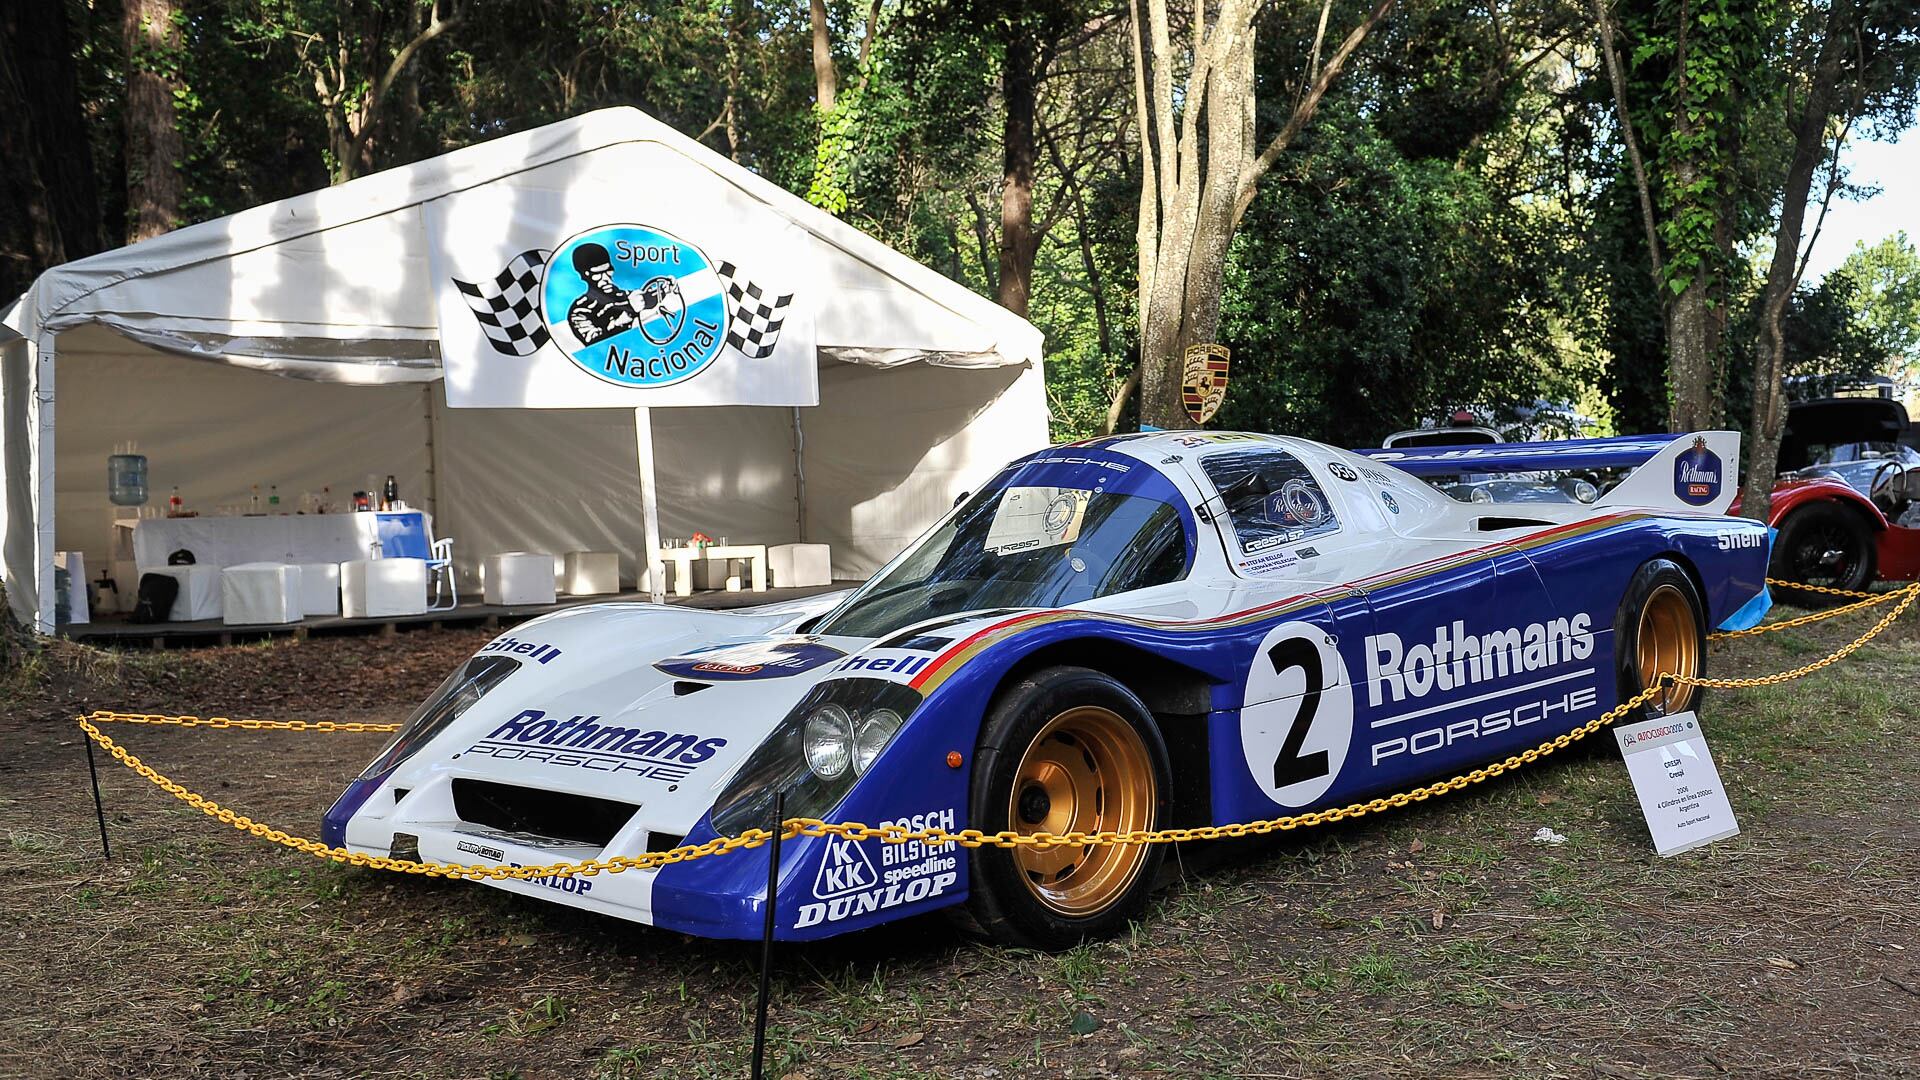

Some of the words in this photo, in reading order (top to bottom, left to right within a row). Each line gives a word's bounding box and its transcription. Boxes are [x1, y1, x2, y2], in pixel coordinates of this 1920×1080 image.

[616, 240, 680, 266] Sport
[605, 320, 719, 378] Nacional
[1186, 345, 1229, 357] PORSCHE
[1329, 462, 1357, 480] 956
[1679, 460, 1718, 484] Rothmans
[1717, 528, 1761, 550] Shell
[1364, 612, 1596, 708] Rothmans
[1267, 635, 1330, 790] 2
[1371, 686, 1597, 767] PORSCHE
[486, 709, 728, 765] Rothmans
[463, 745, 697, 783] PORSCHE
[1664, 758, 1682, 768] CRESPI
[1669, 769, 1684, 779] Crespi
[1679, 802, 1700, 813] Argentina
[879, 808, 955, 845] BOSCH
[832, 841, 854, 866] K
[882, 832, 956, 867] BILSTEIN
[825, 861, 866, 892] KK
[883, 857, 956, 886] speedline
[793, 871, 957, 929] DUNLOP
